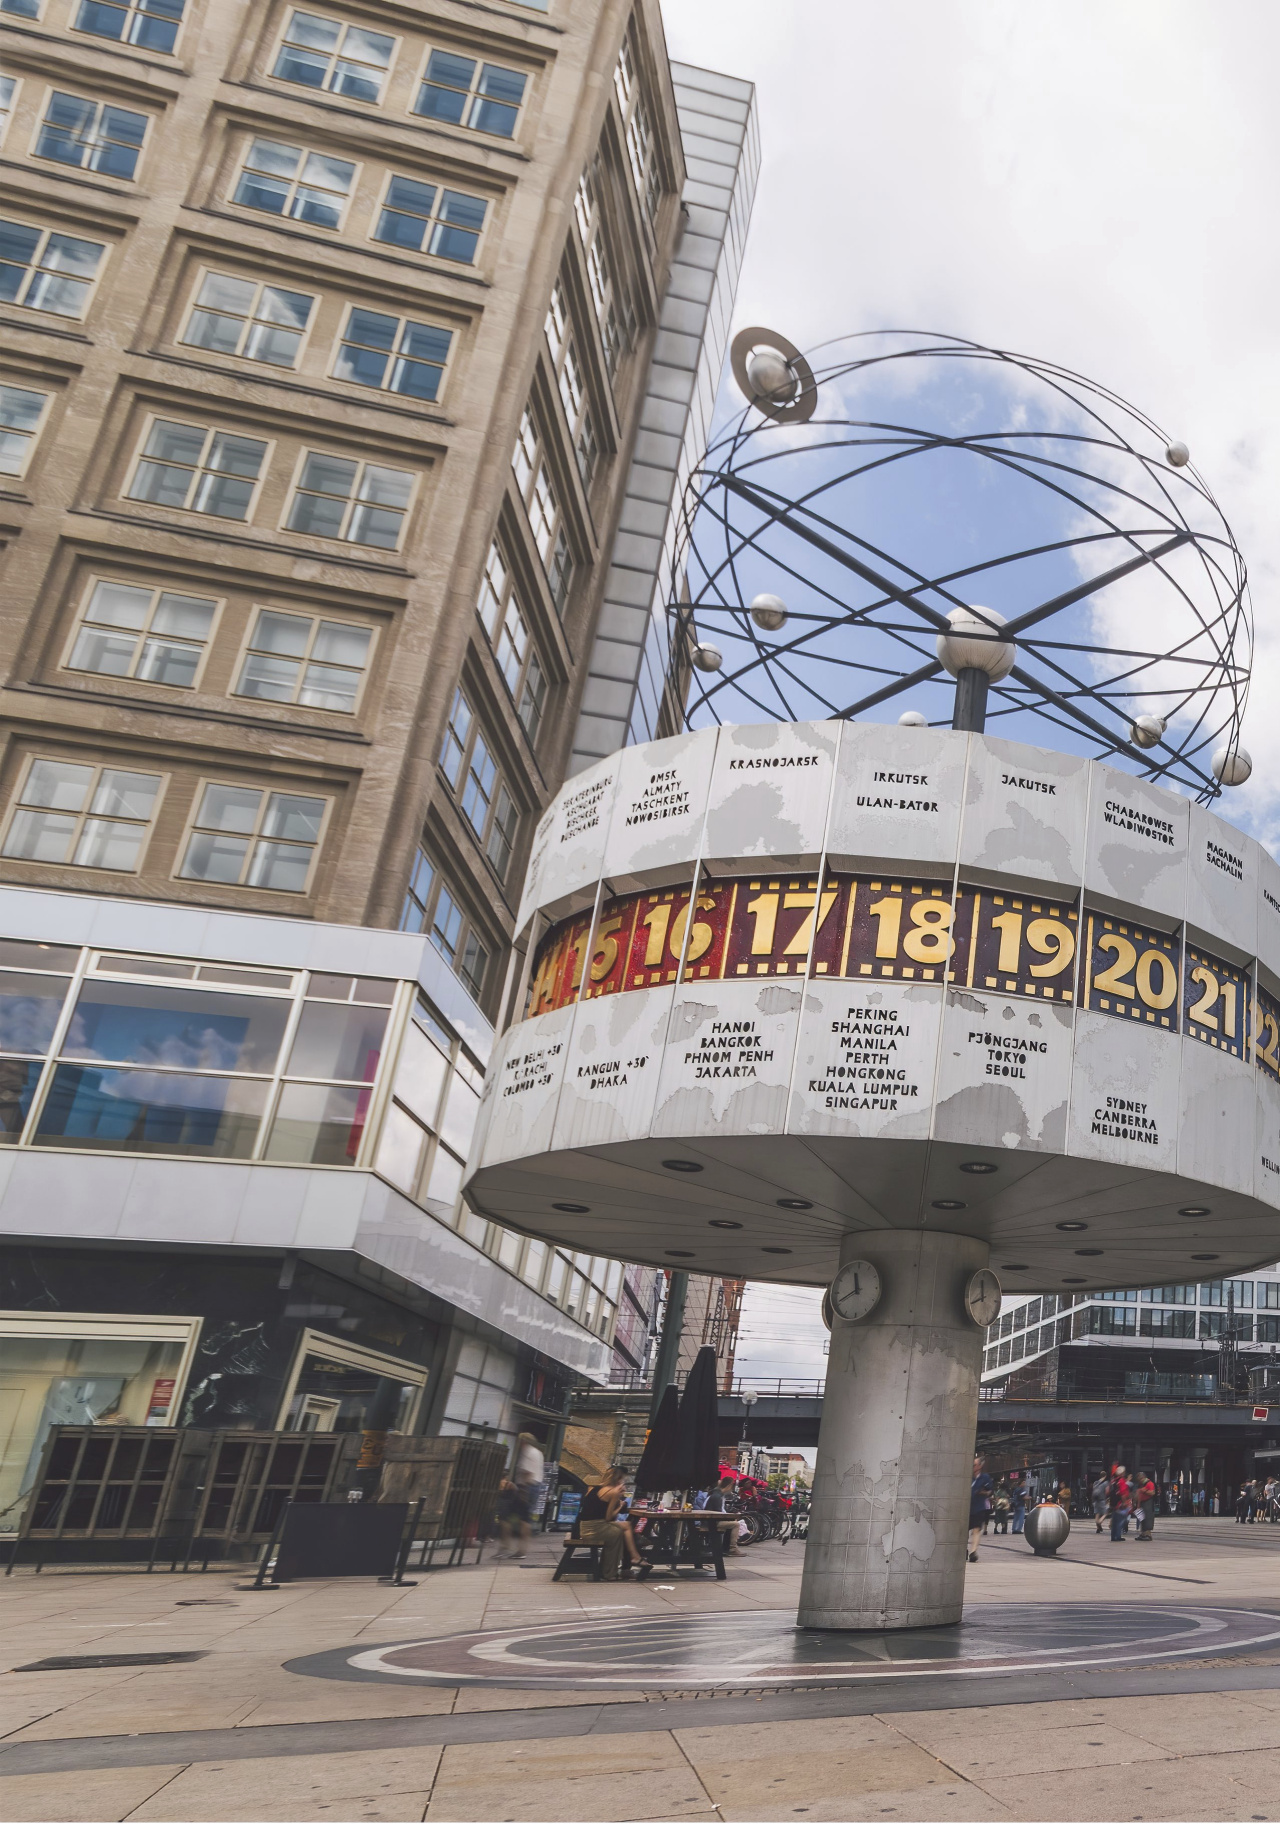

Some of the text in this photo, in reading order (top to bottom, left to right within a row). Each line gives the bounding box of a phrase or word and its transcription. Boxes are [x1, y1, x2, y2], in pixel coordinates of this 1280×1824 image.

[730, 756, 819, 770] KRASNOJARSK
[650, 770, 677, 785] OMSK
[873, 772, 929, 786] IRKUTSK
[1001, 774, 1056, 795] JAKUTSK
[642, 781, 682, 798] ALMATY
[631, 792, 690, 813] TASCHKENT
[857, 796, 939, 812] ULAN-BATOR
[625, 804, 690, 827] NOWOSIBIRSK
[1105, 800, 1174, 834] CHABAROWSK
[1104, 811, 1175, 846] WLADIWOSTOK
[1207, 841, 1243, 869] MAGADAN
[1206, 852, 1243, 880] SACHALIN
[642, 897, 716, 966] 16
[747, 892, 839, 955] 17
[870, 897, 957, 964] 18
[571, 916, 623, 988] 15
[992, 911, 1075, 978] 19
[1093, 933, 1177, 1010] 20
[1188, 966, 1237, 1039] 21
[847, 1007, 898, 1021] PEKING
[712, 1021, 755, 1034] HANOI
[831, 1021, 910, 1037] SHANGHAI
[1247, 1001, 1279, 1072] 22
[700, 1035, 762, 1049] BANGKOK
[840, 1037, 897, 1051] MANILA
[968, 1031, 1048, 1054] PJÖNGJANG
[506, 1057, 521, 1071] NEW
[524, 1049, 545, 1064] DELHI
[684, 1050, 774, 1064] PHNOM PENH
[845, 1052, 890, 1065] PERTH
[988, 1049, 1027, 1065] TOKYO
[577, 1060, 621, 1078] RANGUN
[695, 1065, 757, 1079] JAKARTA
[826, 1066, 906, 1081] HONGKONG
[985, 1063, 1026, 1079] SEOUL
[503, 1079, 535, 1097] COLOMBO
[590, 1074, 628, 1090] DHAKA
[808, 1080, 919, 1097] KUALA LUMPUR
[825, 1096, 898, 1111] SINGAPUR
[1106, 1096, 1147, 1115] SYDNEY
[1095, 1108, 1157, 1131] CANBERRA
[1091, 1122, 1159, 1145] MELBOURNE
